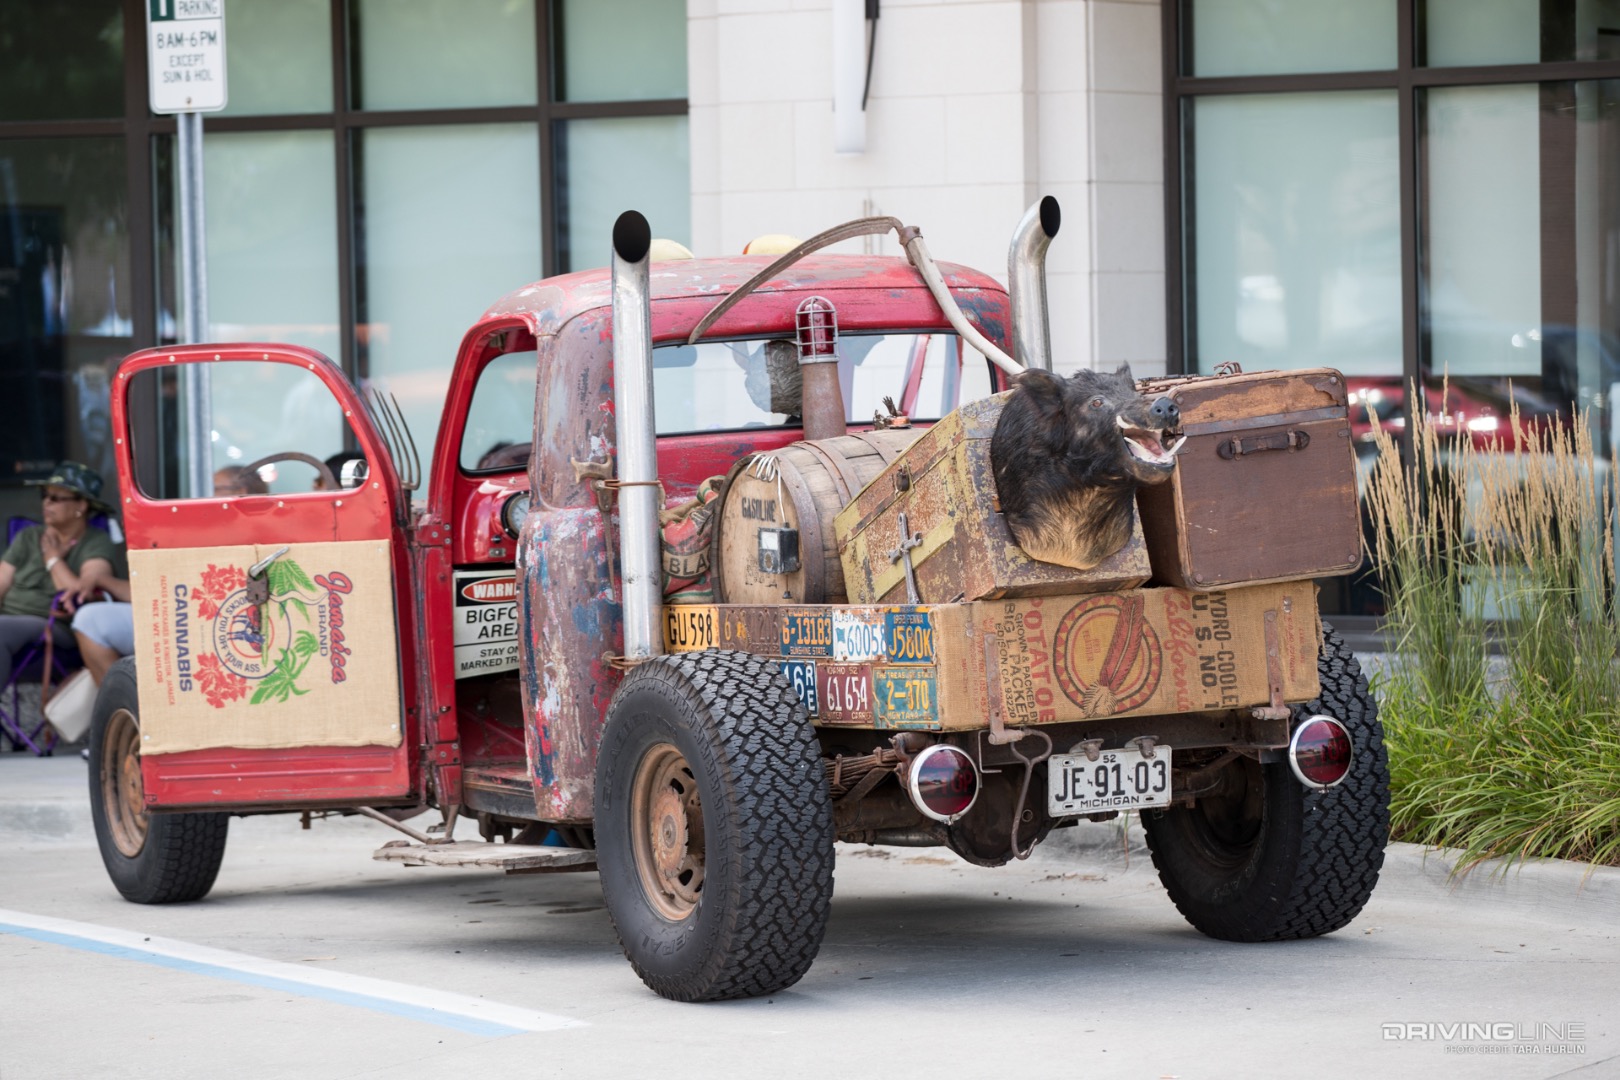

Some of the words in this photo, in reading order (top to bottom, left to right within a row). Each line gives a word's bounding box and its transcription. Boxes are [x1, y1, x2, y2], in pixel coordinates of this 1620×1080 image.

[169, 53, 205, 68] EXCEPT
[162, 71, 182, 83] SUN
[195, 69, 213, 81] HOL
[741, 497, 776, 522] GASOLINE
[668, 554, 709, 576] BLA
[473, 583, 516, 598] WARN
[219, 616, 230, 632] YOU
[466, 606, 517, 624] BIGFO
[1003, 603, 1016, 633] BIG
[174, 584, 193, 692] CANNABIS
[314, 571, 353, 684] Jamaica
[318, 604, 329, 657] BRAND
[782, 618, 831, 645] 6-13183
[1015, 612, 1029, 653] GROWN
[153, 642, 161, 654] 50
[160, 575, 169, 599] PACKED
[166, 680, 175, 706] JAMAICA
[789, 646, 811, 655] SUNSHINE
[812, 646, 826, 655] STATE
[847, 624, 886, 656] 60058
[224, 650, 243, 670] YOUR
[480, 647, 505, 658] STAY
[1021, 655, 1030, 664] &
[1024, 598, 1056, 723] POTATOE
[154, 656, 164, 684] KILOS
[243, 663, 261, 673] ASS
[460, 658, 502, 671] MARKED
[1001, 668, 1010, 684] CA
[886, 680, 930, 711] 2-370
[1009, 654, 1029, 723] PACKER
[1022, 666, 1035, 709] PACKED
[1004, 687, 1017, 718] 93220
[1029, 711, 1038, 723] BY
[1103, 754, 1117, 764] 52
[1080, 796, 1140, 808] MICHIGAN
